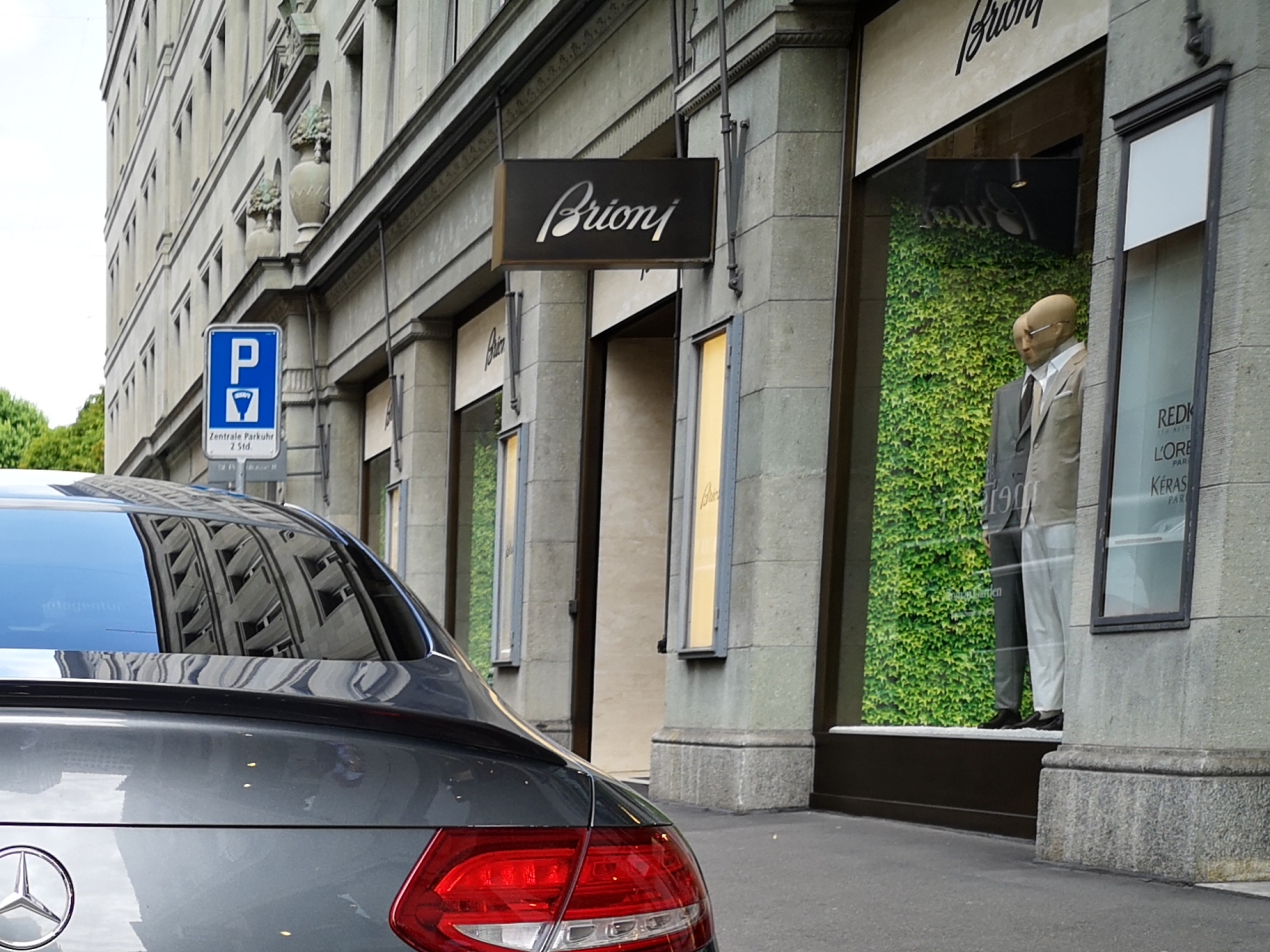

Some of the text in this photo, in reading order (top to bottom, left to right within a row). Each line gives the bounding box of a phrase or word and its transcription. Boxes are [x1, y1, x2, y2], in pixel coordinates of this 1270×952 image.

[536, 180, 680, 242] Brioni
[231, 338, 259, 385] P
[209, 432, 274, 441] Zentrale Parkuhr
